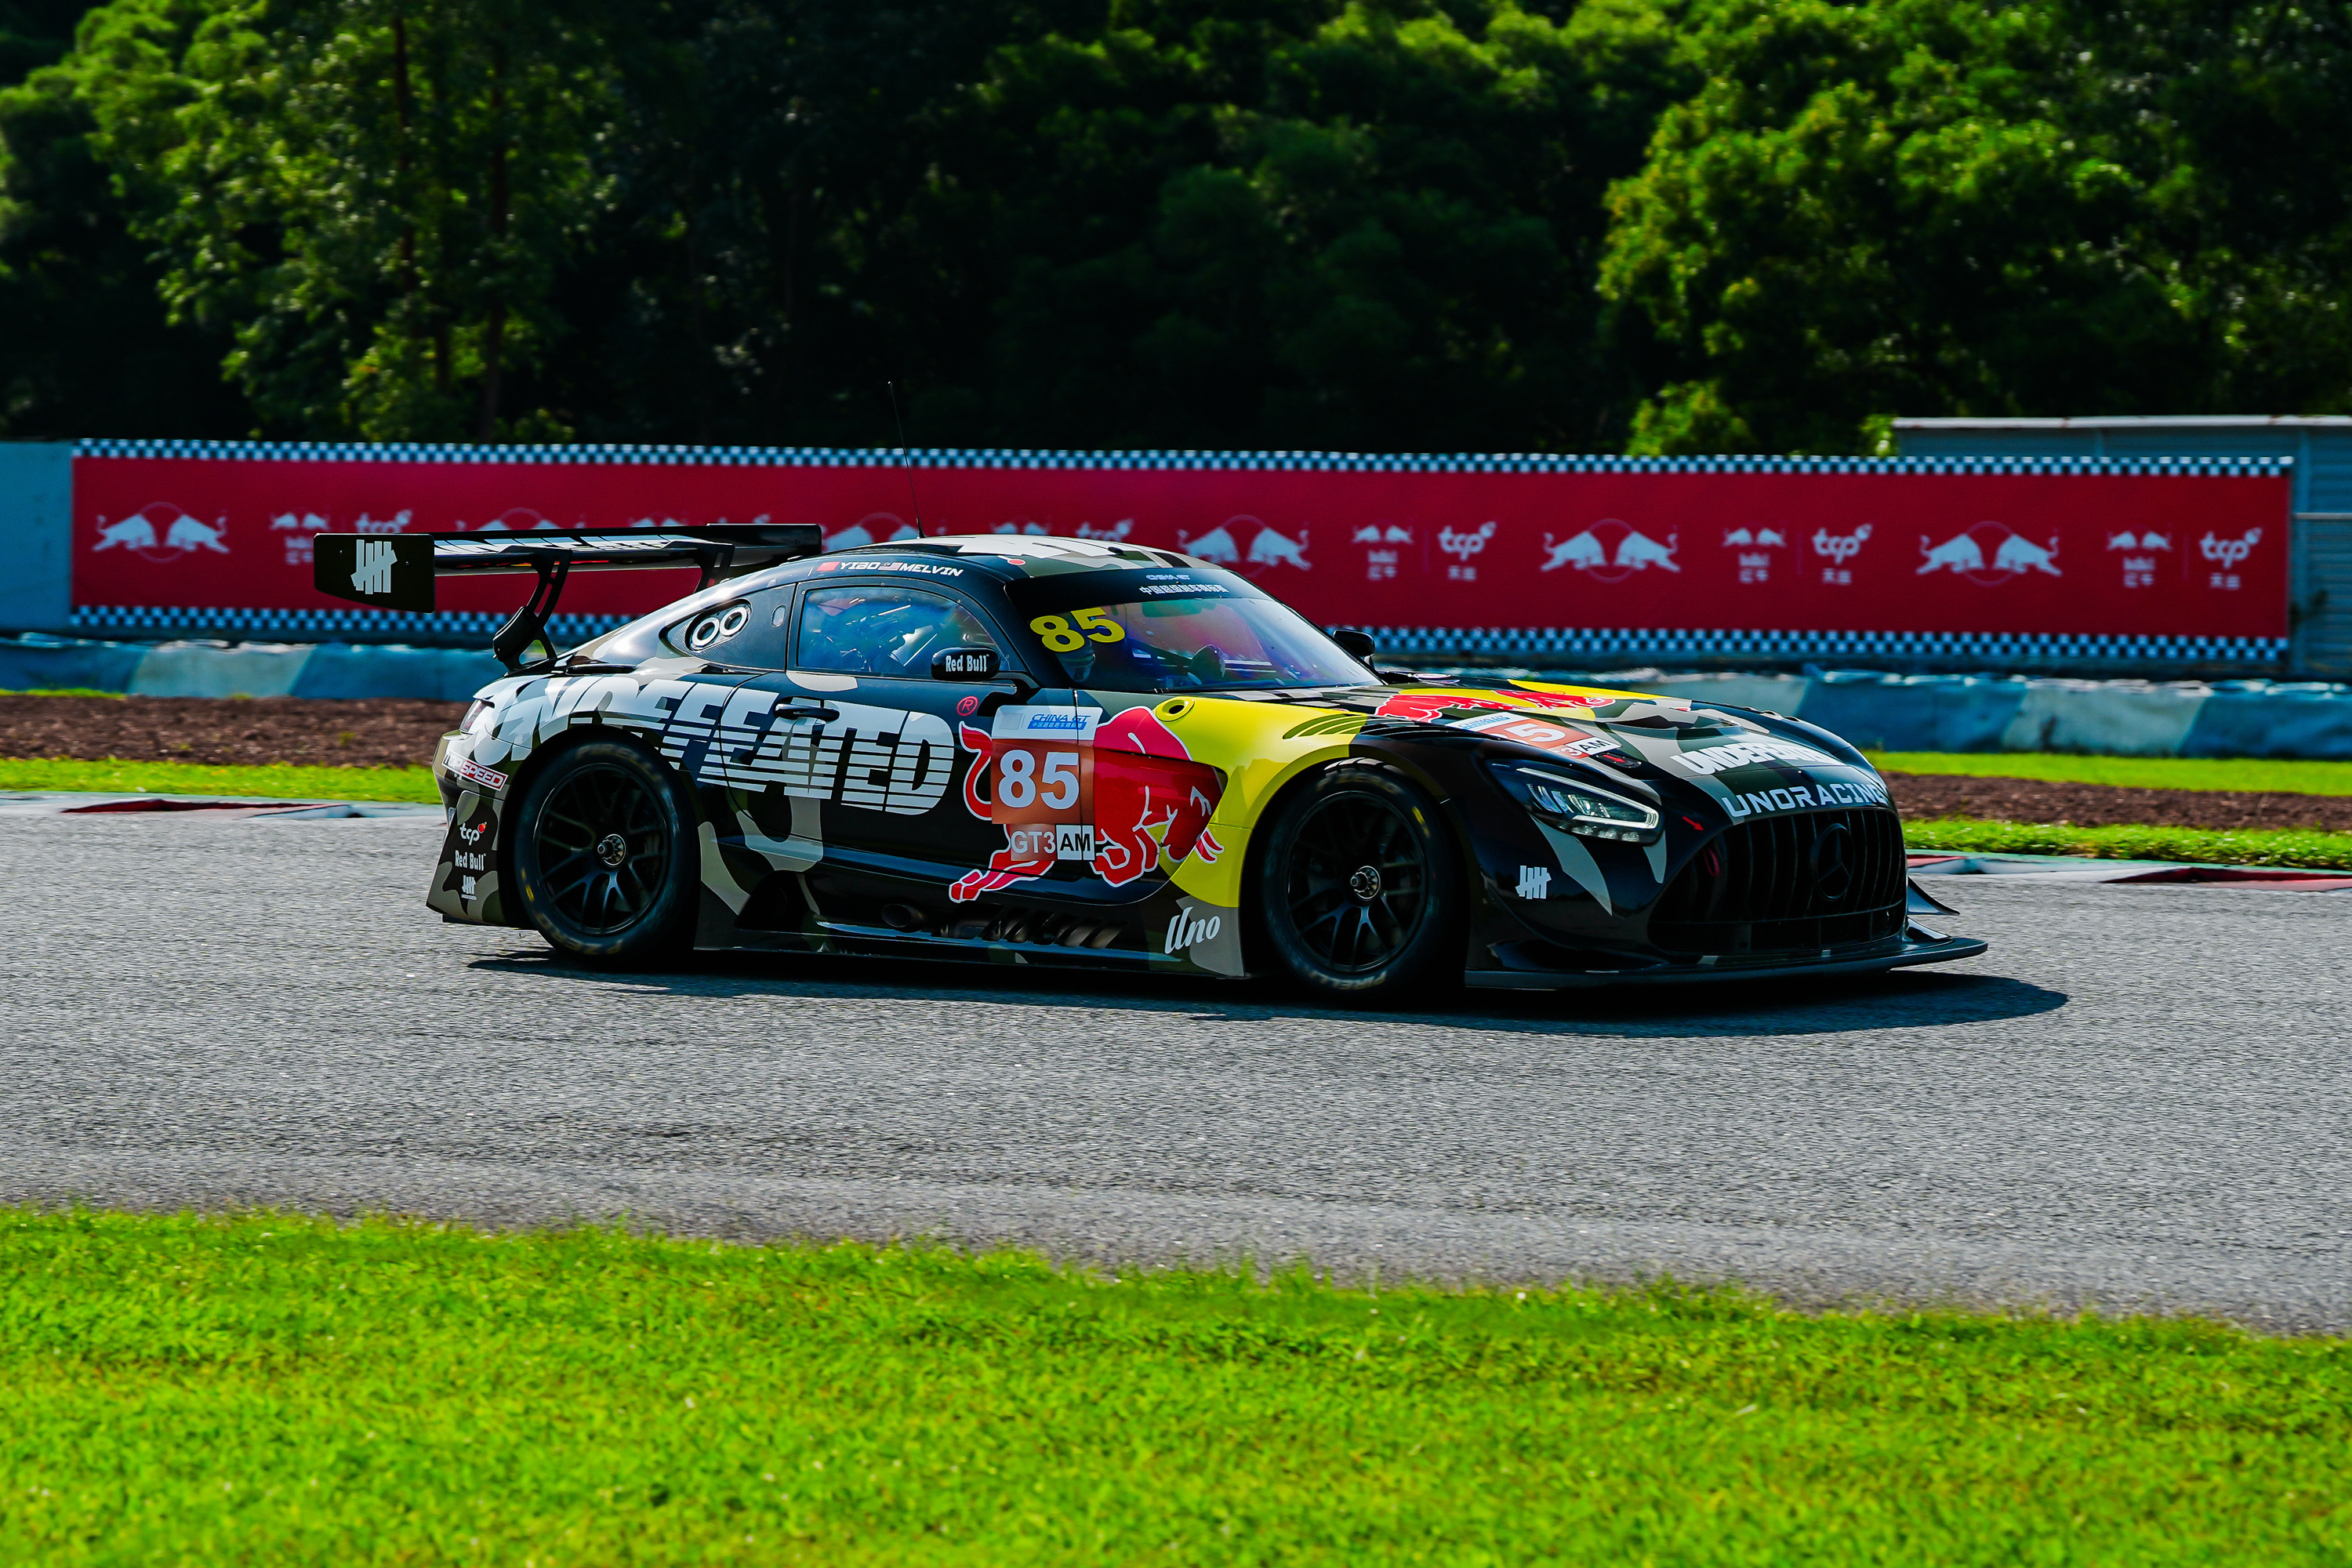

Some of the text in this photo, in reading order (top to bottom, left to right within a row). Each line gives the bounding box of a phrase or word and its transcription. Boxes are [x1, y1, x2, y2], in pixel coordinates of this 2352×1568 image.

[1438, 525, 1485, 561] tcp
[1812, 527, 1860, 565] tcp
[2199, 531, 2250, 569] tcp
[898, 562, 964, 577] MELVIN
[1029, 607, 1126, 653] 85
[946, 655, 987, 673] Red Bull
[1031, 713, 1069, 722] CHINA
[1490, 722, 1566, 746] 5
[1578, 740, 1610, 751] AM
[998, 750, 1080, 810] 85
[459, 823, 481, 846] tcp
[1011, 831, 1091, 854] GT3 AM
[455, 849, 485, 872] Red Bull
